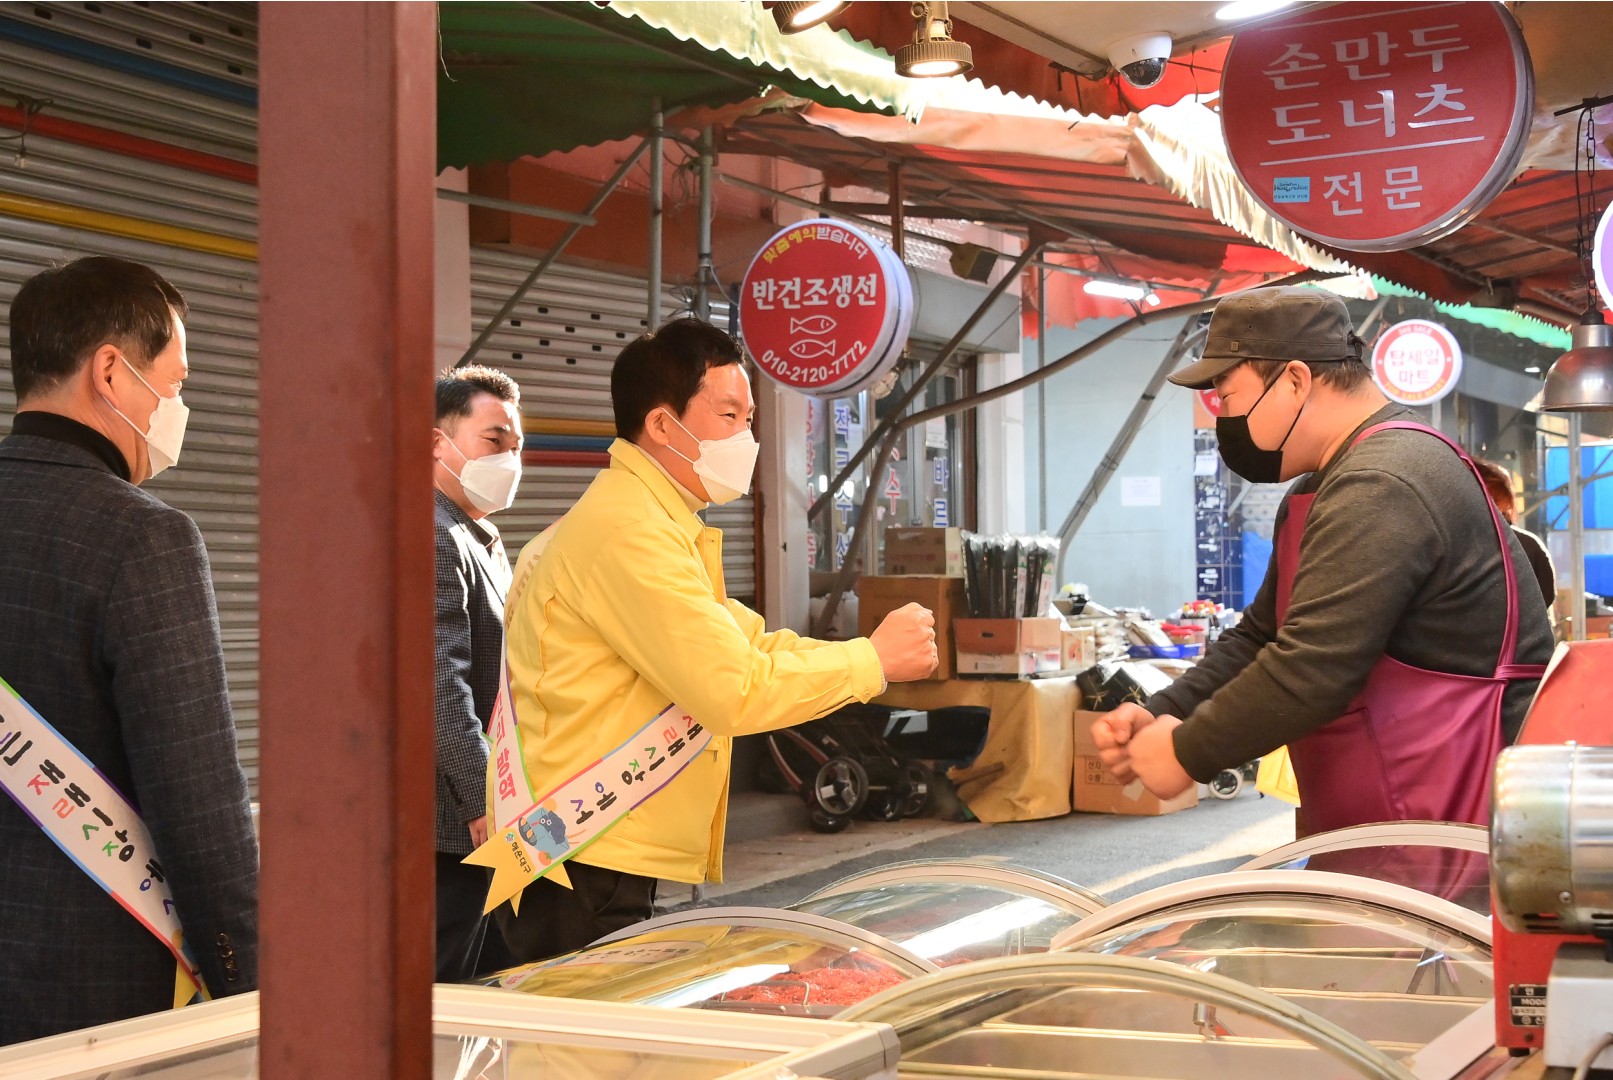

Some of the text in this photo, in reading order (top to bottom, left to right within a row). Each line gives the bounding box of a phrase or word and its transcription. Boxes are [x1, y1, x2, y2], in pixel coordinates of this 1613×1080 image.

[1262, 24, 1470, 91] 손만두
[1267, 84, 1475, 146] 도너츠
[1323, 166, 1424, 217] 전문
[752, 273, 877, 310] 반건조생선
[761, 340, 868, 383] 010-2120-7772
[1390, 348, 1440, 367] 탑세일
[1398, 369, 1431, 385] 마트
[496, 747, 517, 801] 방역
